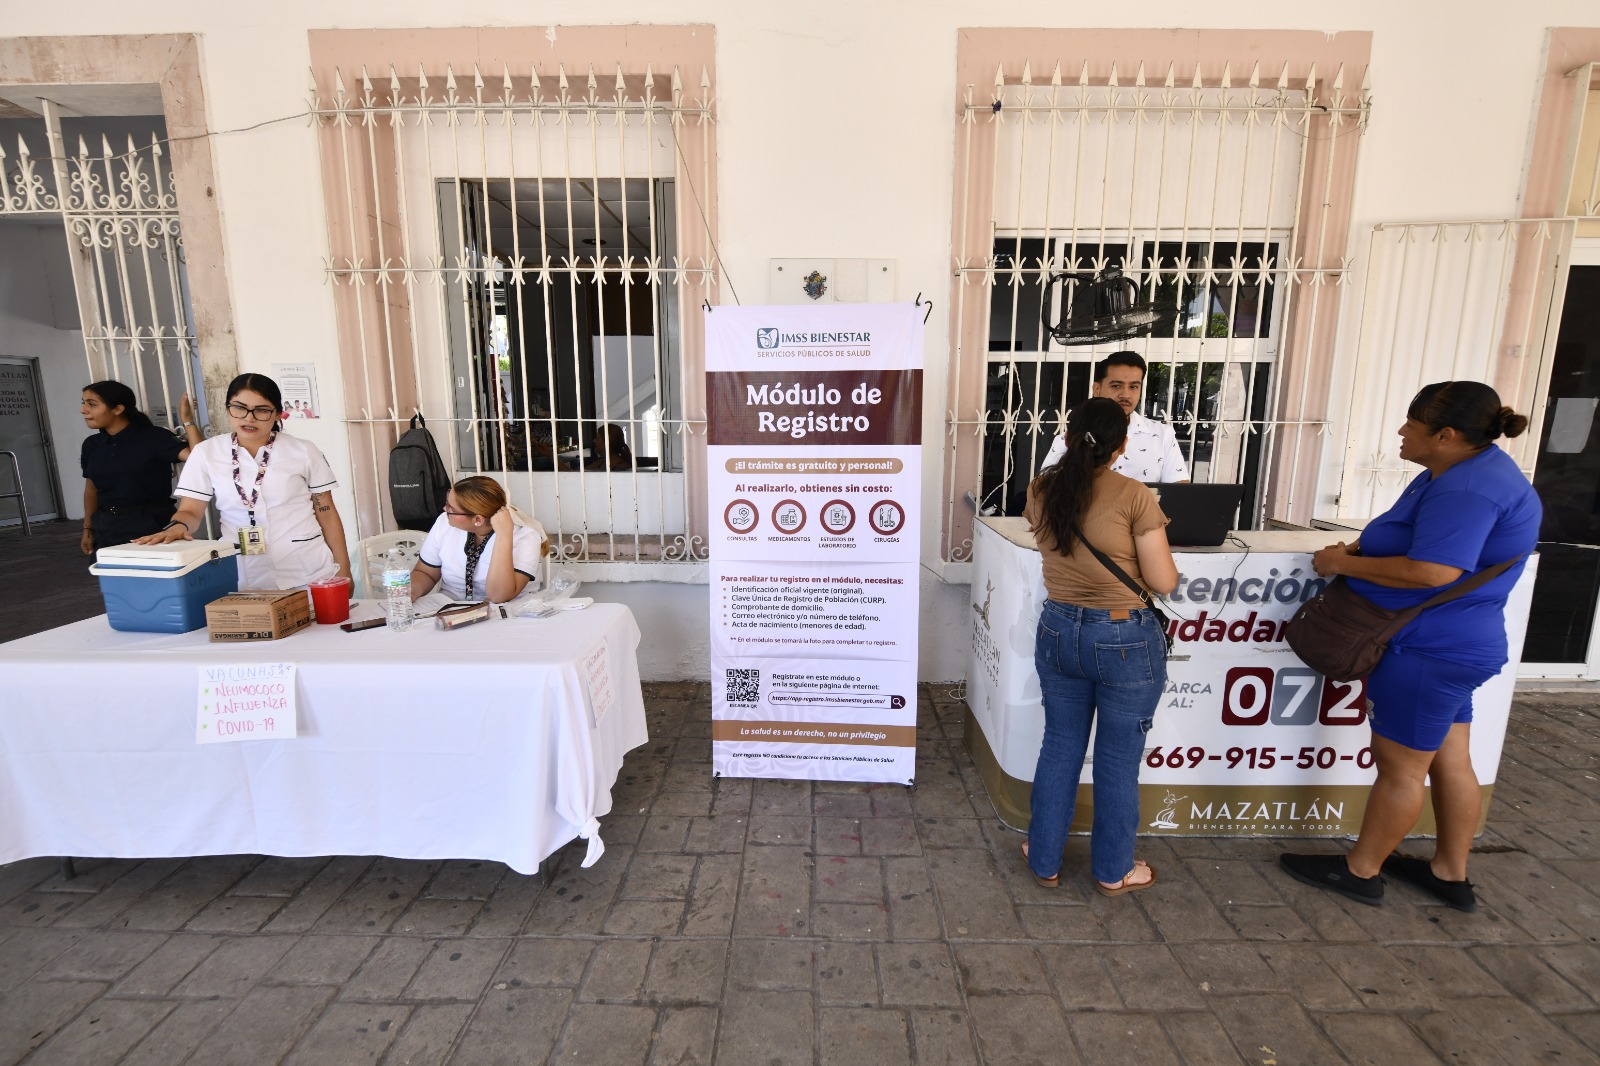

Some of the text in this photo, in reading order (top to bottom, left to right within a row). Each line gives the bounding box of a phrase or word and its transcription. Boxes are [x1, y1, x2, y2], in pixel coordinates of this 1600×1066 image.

[781, 332, 870, 343] IMSS BIENESTAR
[746, 381, 882, 406] Módulo de
[758, 411, 870, 439] Registro
[735, 462, 745, 471] ¡El
[747, 461, 784, 470] trámite
[799, 462, 838, 472] gratuito
[840, 463, 845, 471] y
[848, 461, 893, 472] personal!
[735, 484, 893, 493] Al realizarlo, obtienes sin costo:
[739, 575, 767, 583] realizar
[779, 576, 810, 584] registro
[834, 576, 863, 585] módulo,
[865, 577, 904, 585] necesitas:
[802, 587, 829, 595] vigente
[831, 587, 865, 595] (original).
[1170, 568, 1327, 604] tención
[751, 594, 771, 602] Única
[783, 596, 812, 604] Registro
[860, 596, 886, 604] (CURP).
[731, 604, 779, 612] Comprobante
[731, 612, 755, 620] Correo
[756, 612, 795, 620] electrónico
[796, 613, 808, 621] y/o
[809, 613, 837, 621] número
[849, 614, 880, 622] teléfono.
[759, 621, 798, 629] nacimiento
[799, 622, 833, 630] (menores
[845, 622, 866, 630] edad).
[206, 666, 276, 680] VACUNAS
[830, 674, 855, 682] módulo
[215, 682, 285, 697] NEUMOCOCO
[819, 682, 841, 691] página
[1163, 682, 1212, 695] ARCA
[1167, 697, 1194, 708] AL:
[1228, 675, 1363, 719] 072
[217, 717, 275, 736] COVID-19
[794, 729, 826, 738] derecho,
[850, 731, 886, 740] privilegio
[1146, 746, 1375, 769] 669-915-50-0
[1190, 797, 1344, 820] MAZATLÁN
